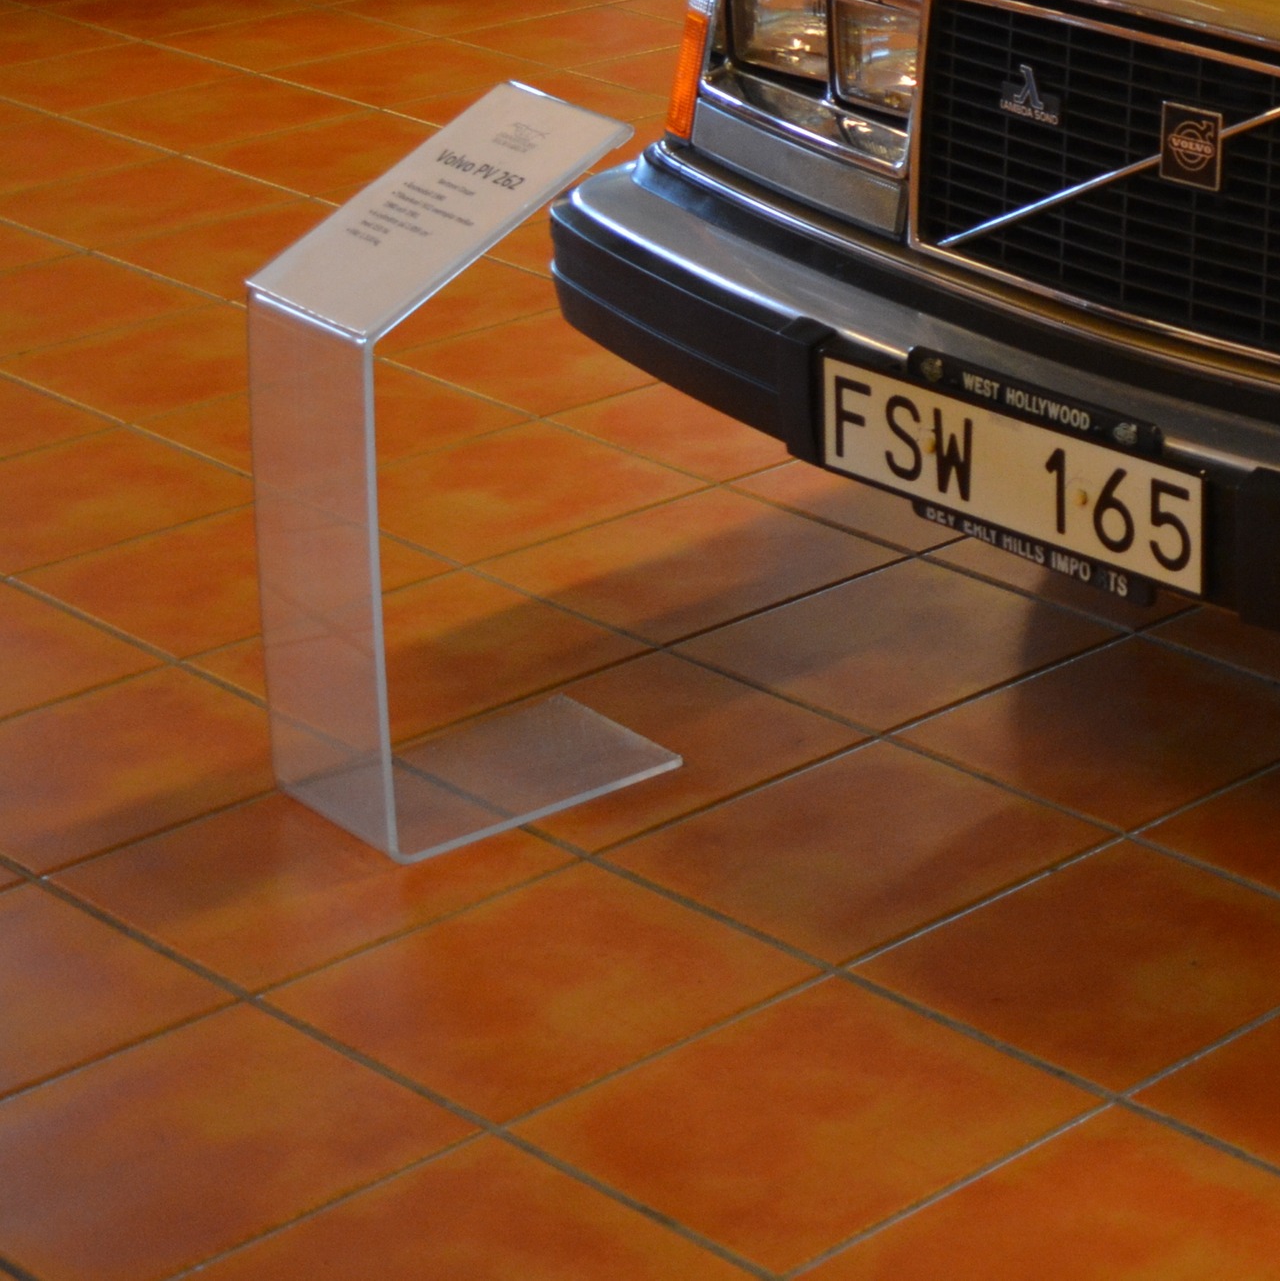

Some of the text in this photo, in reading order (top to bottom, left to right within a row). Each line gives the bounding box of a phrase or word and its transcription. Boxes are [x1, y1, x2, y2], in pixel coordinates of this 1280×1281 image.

[1170, 136, 1213, 155] VOLVO
[436, 148, 475, 173] Volvo
[473, 163, 500, 182] PV
[493, 171, 526, 191] 262
[962, 371, 1091, 431] WEST HOLLYWOOD
[834, 375, 1192, 572] FSW 165
[1002, 533, 1046, 564] HILLS
